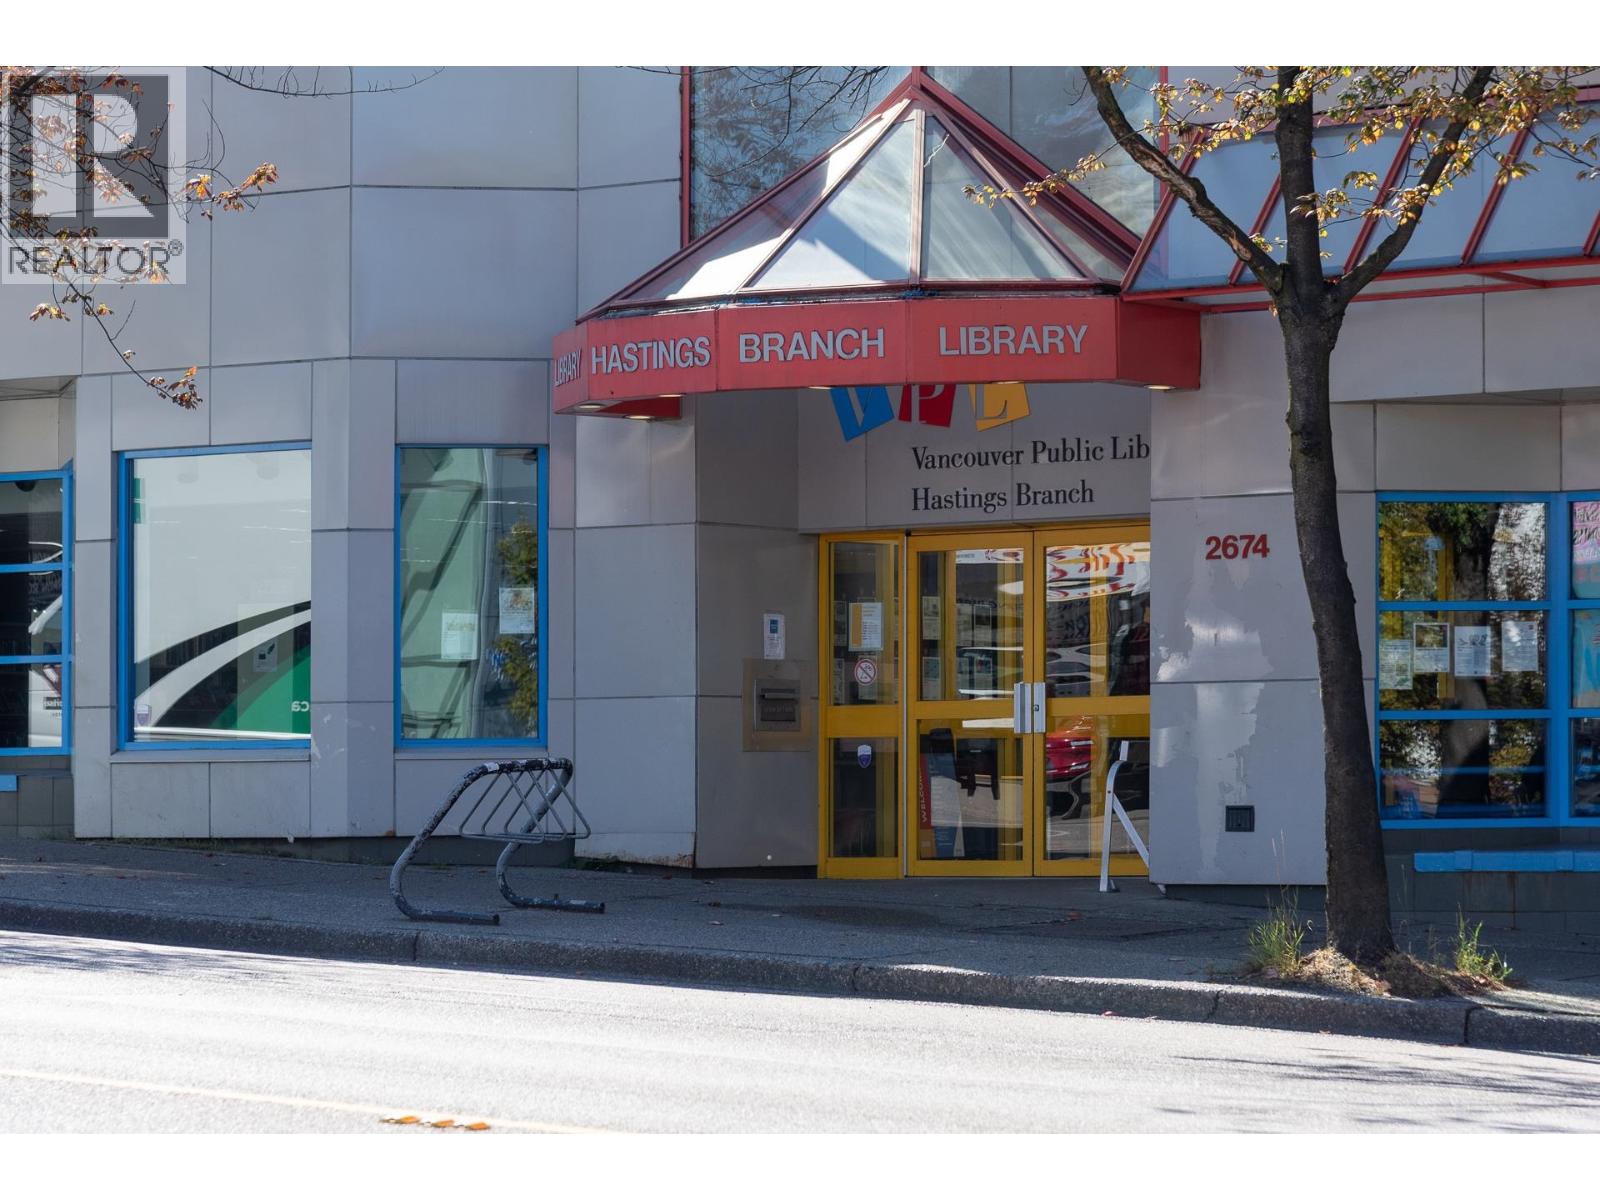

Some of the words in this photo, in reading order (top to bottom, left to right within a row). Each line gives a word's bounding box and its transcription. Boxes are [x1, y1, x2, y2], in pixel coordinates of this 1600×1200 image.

[591, 336, 711, 375] HASTINGS
[738, 328, 885, 363] BRANCH
[938, 324, 1089, 357] LIBRARY
[554, 349, 582, 387] LIBRARY
[911, 446, 1025, 470] Vancouver
[1031, 437, 1104, 465] Public
[911, 486, 1007, 514] Hastings
[1015, 479, 1096, 506] Branch
[1205, 534, 1270, 560] 2674
